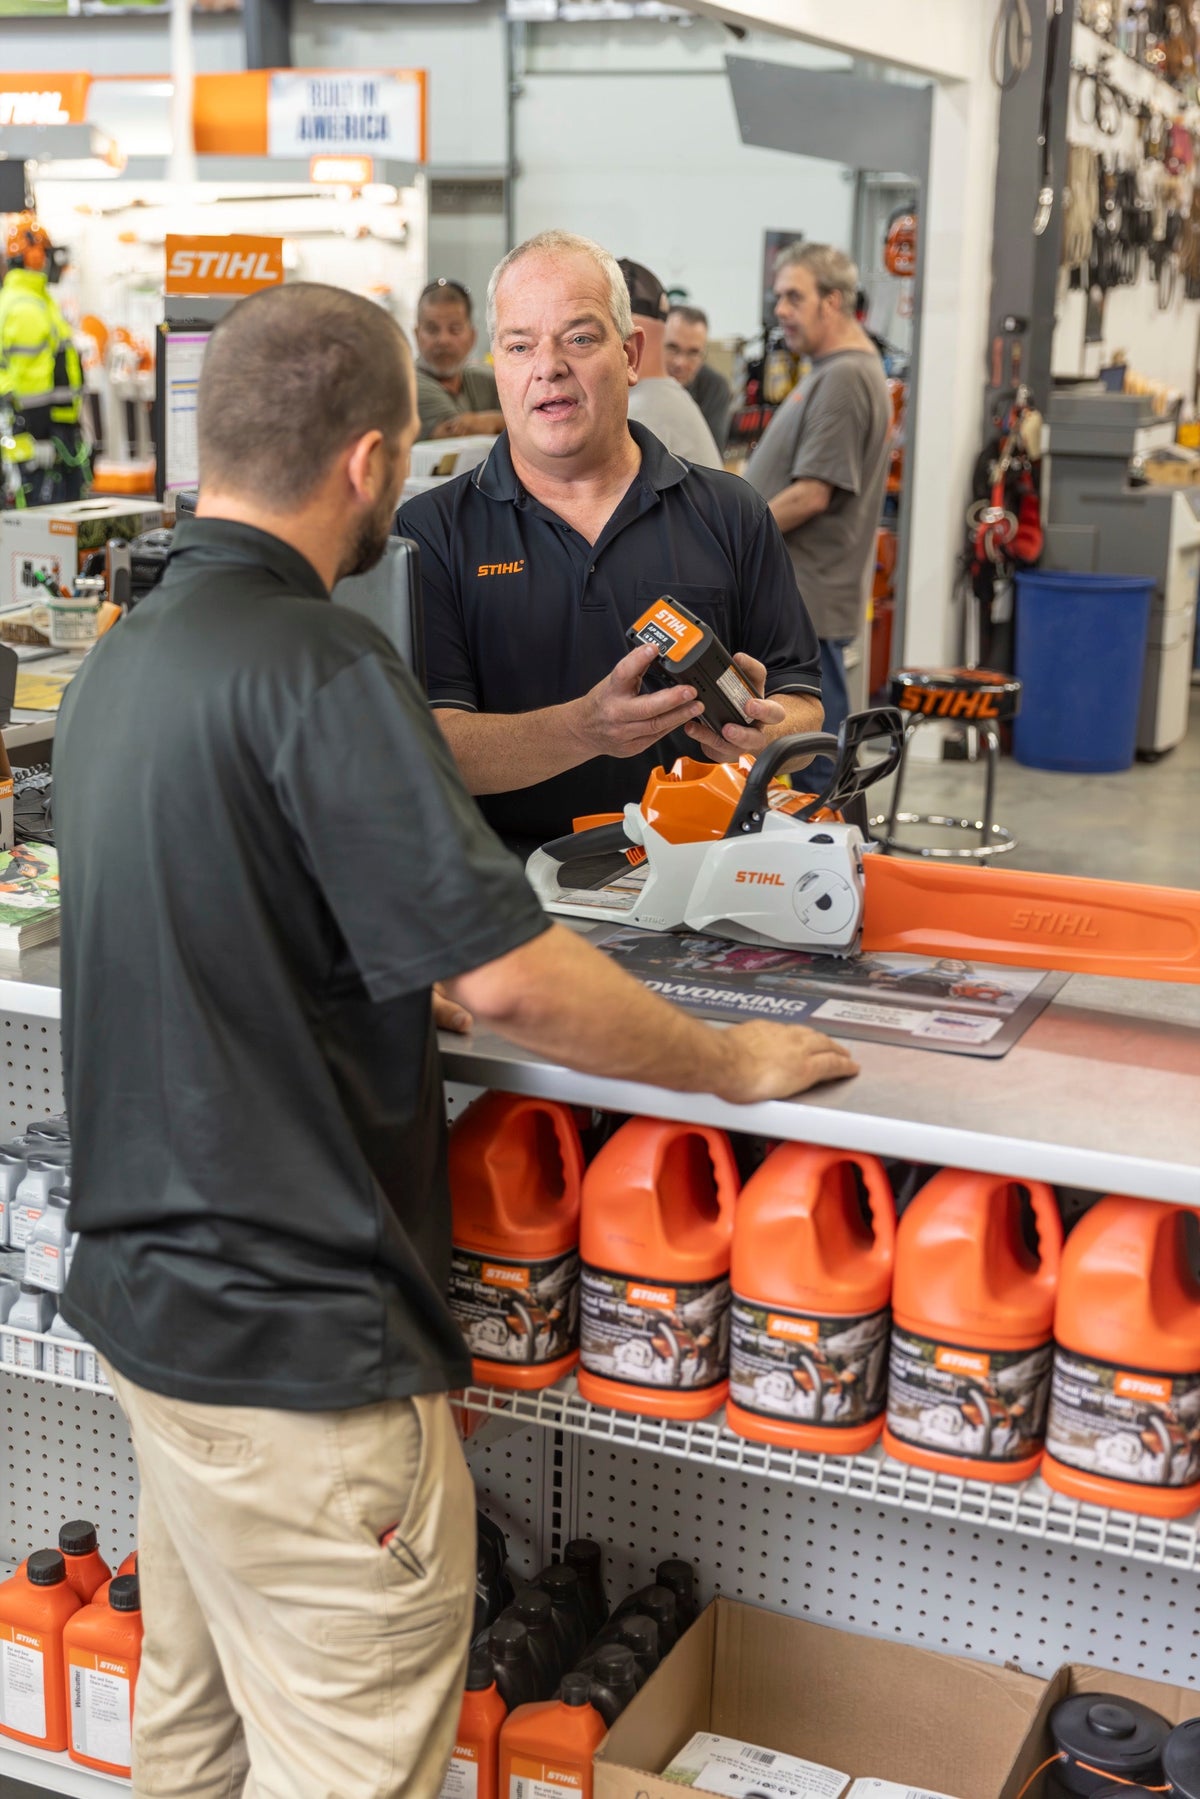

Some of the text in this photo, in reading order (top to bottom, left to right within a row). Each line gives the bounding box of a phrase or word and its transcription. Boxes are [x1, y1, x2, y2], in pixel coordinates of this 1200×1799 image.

[298, 113, 391, 141] AMERICA
[168, 249, 278, 279] STIHL
[477, 561, 524, 577] STIHL
[655, 609, 688, 637] STIHL
[899, 685, 999, 719] STIHL
[735, 870, 785, 886] STIHL
[1009, 909, 1100, 938] STIHL
[485, 1268, 525, 1283] STIHL
[630, 1288, 670, 1304] STIHL
[772, 1319, 814, 1337] STIHL
[940, 1353, 983, 1371] STIHL
[1120, 1378, 1165, 1397] STIHL
[16, 1633, 40, 1647] STIHL
[100, 1660, 126, 1674] STIHL
[547, 1771, 579, 1785] STIHL
